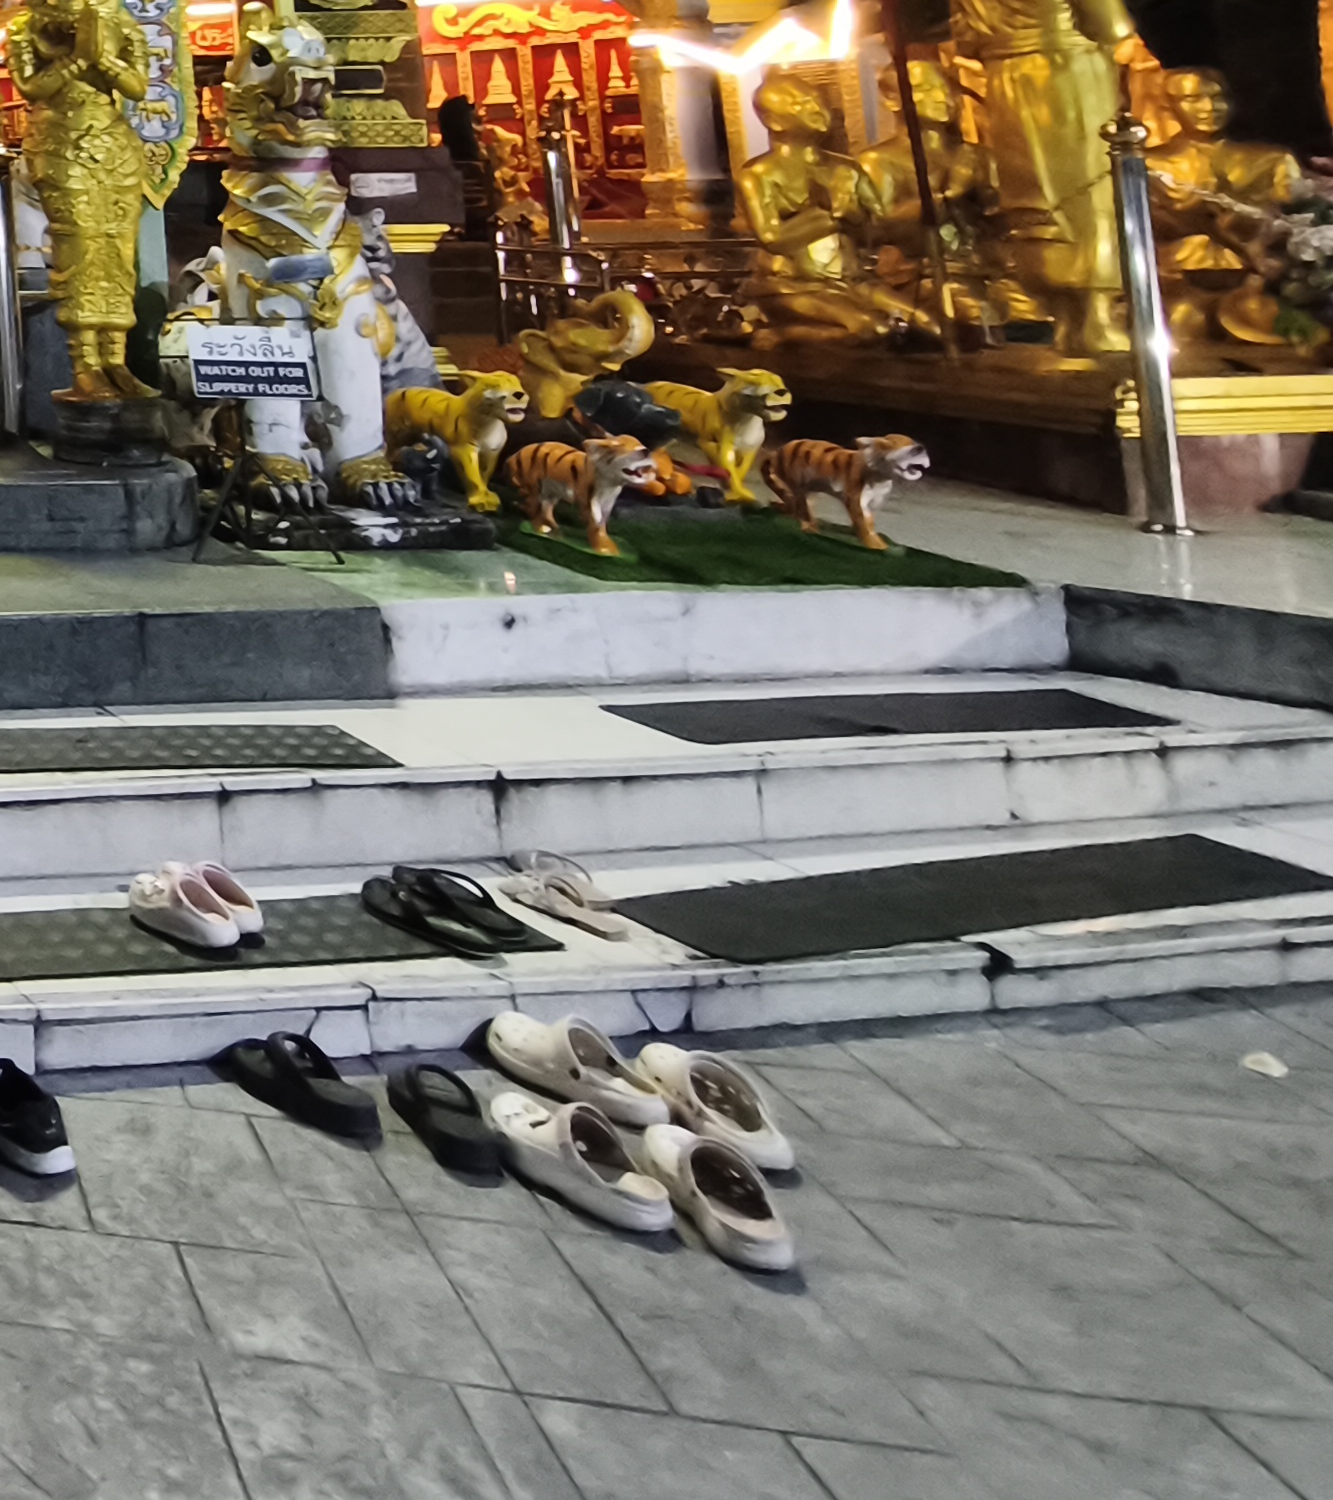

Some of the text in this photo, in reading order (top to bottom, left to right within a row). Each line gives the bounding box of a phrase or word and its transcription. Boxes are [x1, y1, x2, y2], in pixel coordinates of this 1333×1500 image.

[201, 329, 295, 358] ระวังลื่น
[197, 365, 304, 378] WATCH OUT FOR
[197, 382, 255, 393] SLIPPERY
